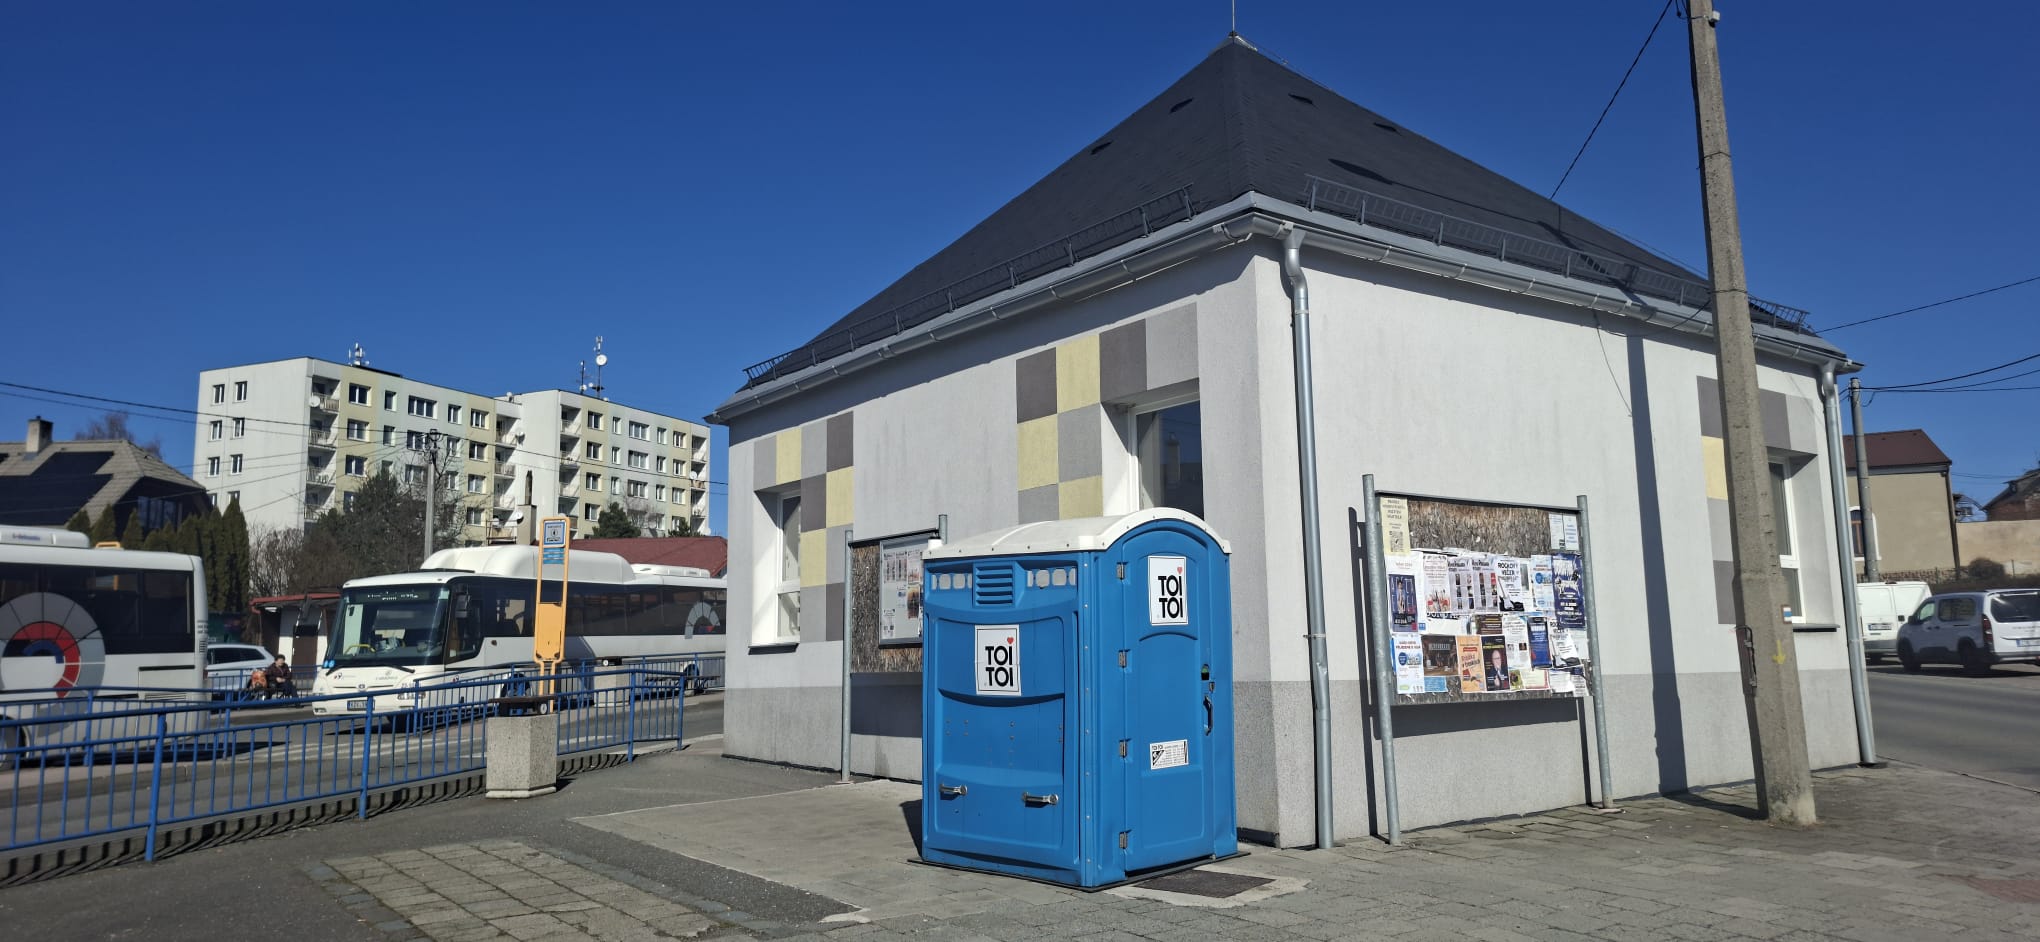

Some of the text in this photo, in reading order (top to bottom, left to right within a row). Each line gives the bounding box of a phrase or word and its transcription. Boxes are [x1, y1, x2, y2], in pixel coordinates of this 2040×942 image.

[1157, 574, 1183, 597] TOI
[1158, 596, 1184, 619] TOI
[984, 645, 1013, 666] TOI
[985, 666, 1014, 687] TOI
